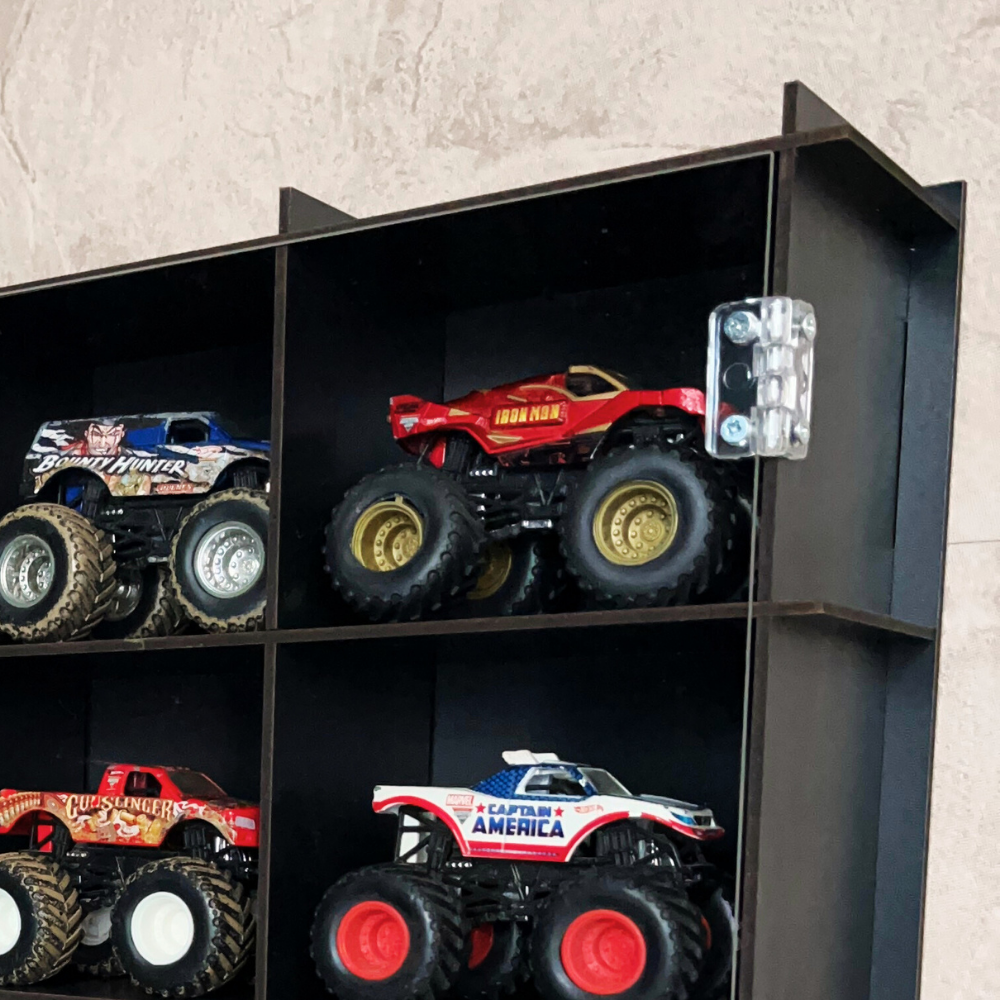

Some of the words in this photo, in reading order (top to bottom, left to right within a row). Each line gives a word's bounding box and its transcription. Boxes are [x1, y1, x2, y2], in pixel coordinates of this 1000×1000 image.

[494, 407, 527, 425] IRON
[32, 455, 114, 473] BOUNTY
[107, 456, 188, 479] HUNTER
[487, 803, 553, 818] CAPTAIN
[471, 815, 565, 839] AMERICA
